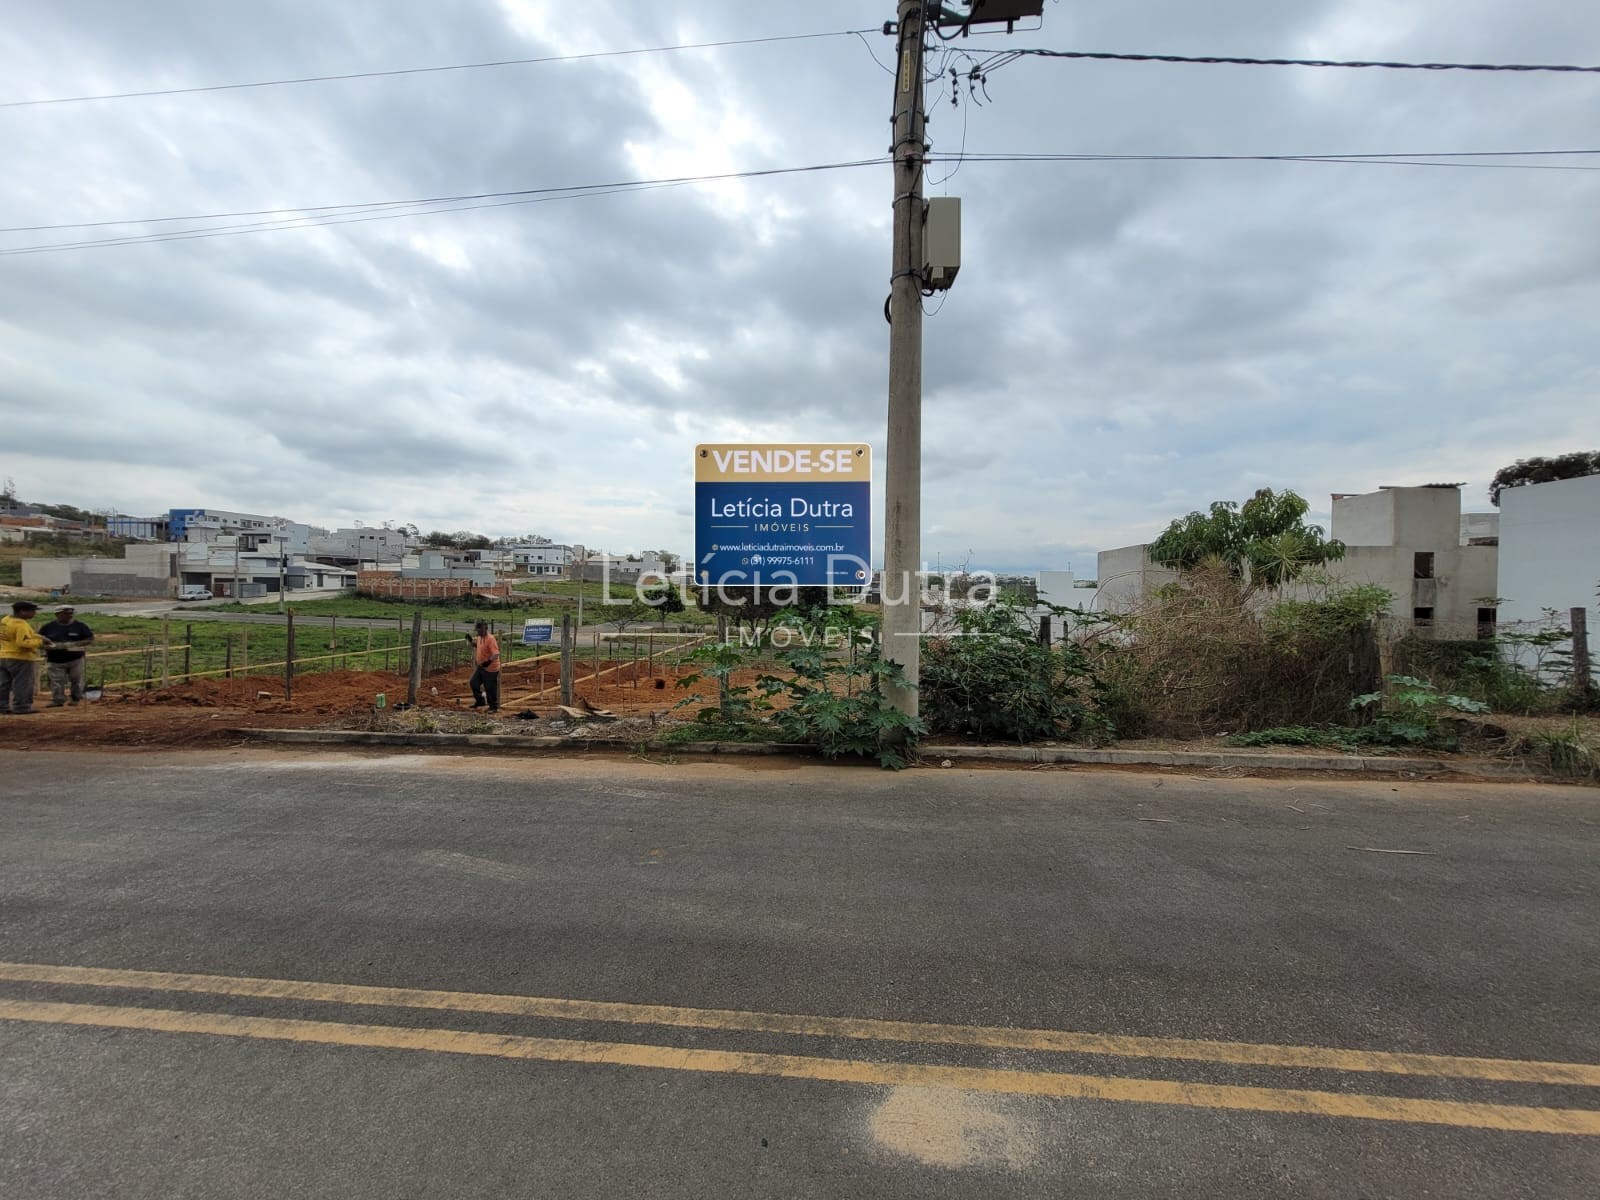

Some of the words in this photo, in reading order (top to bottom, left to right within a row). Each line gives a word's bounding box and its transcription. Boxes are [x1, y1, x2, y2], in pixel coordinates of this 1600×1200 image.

[712, 449, 853, 473] VENDE-SE
[711, 497, 782, 518] Letícia
[790, 498, 853, 518] Dutra
[754, 522, 809, 532] IMÓVEIS
[719, 542, 845, 552] www.leticiadutraimoveis.com.br
[750, 556, 767, 566] (31)
[767, 556, 814, 565] 99975-6111
